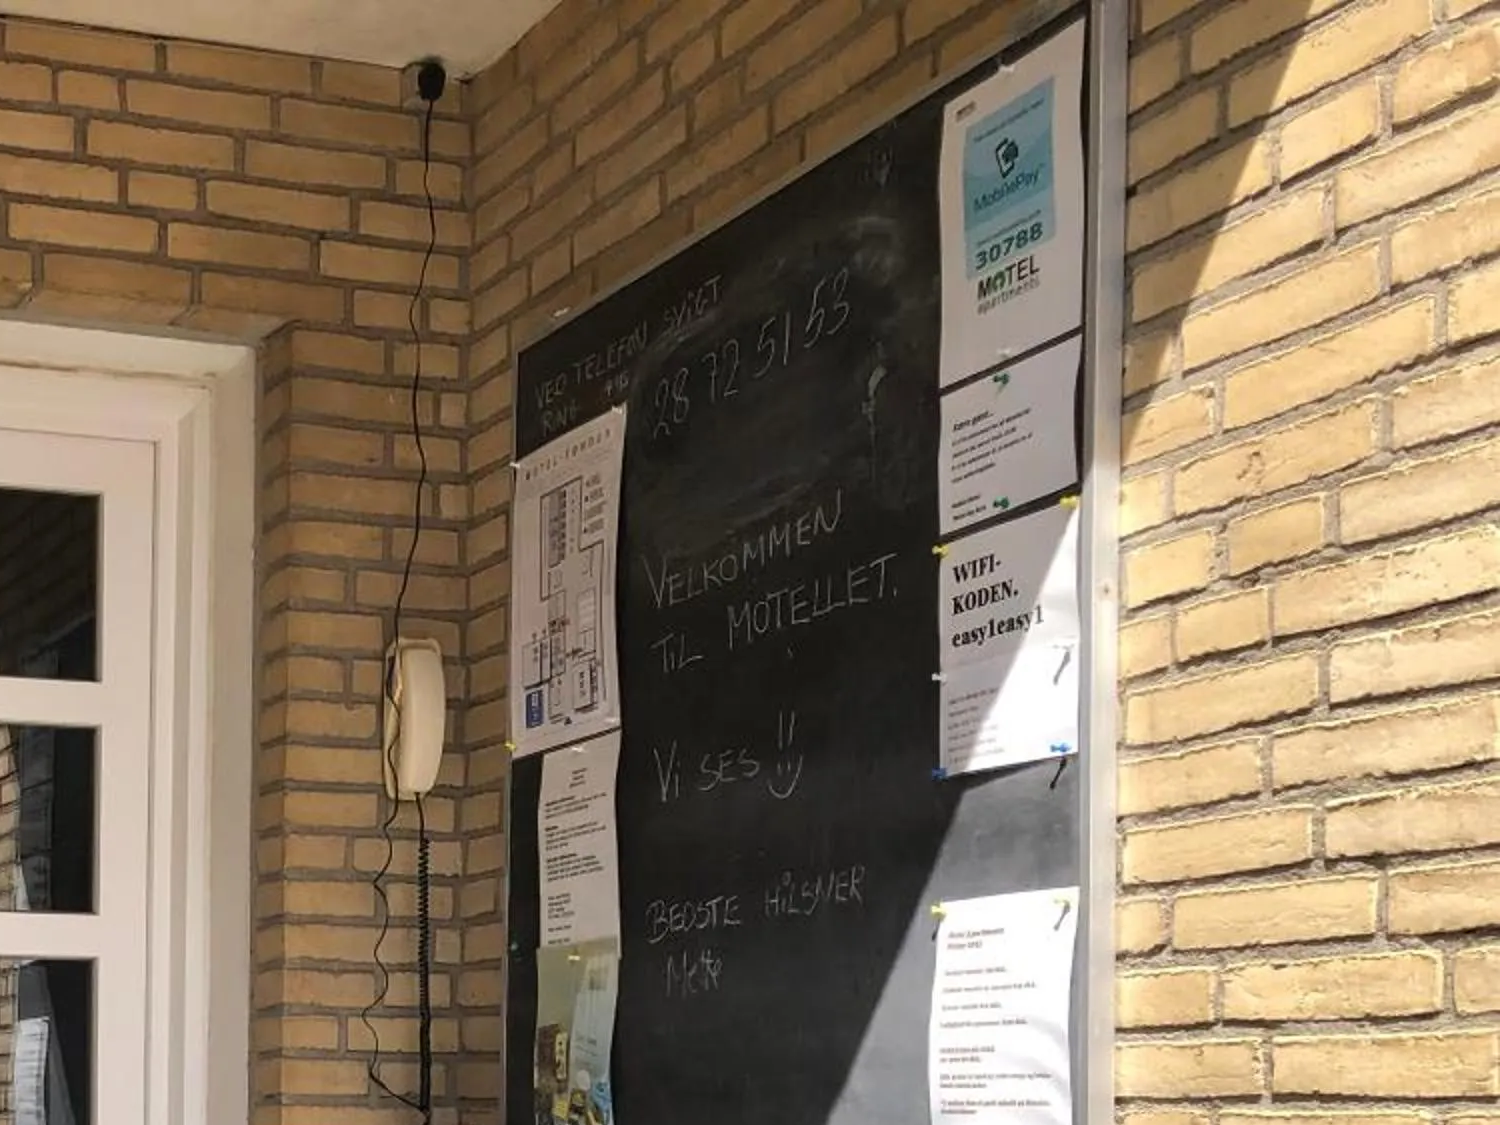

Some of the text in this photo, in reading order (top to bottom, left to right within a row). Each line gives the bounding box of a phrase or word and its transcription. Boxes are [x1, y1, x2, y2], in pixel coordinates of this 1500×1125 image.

[975, 222, 1043, 270] 30788
[977, 254, 1041, 300] MOTEL
[702, 338, 740, 402] 72
[752, 311, 791, 378] 51
[641, 488, 842, 608] VELKOMMEN
[952, 553, 1002, 585] WIFI-
[951, 579, 1019, 617] KODEN.
[951, 604, 1045, 649] easy1easy1
[699, 748, 761, 791] SES
[646, 895, 742, 944] BEDSTE
